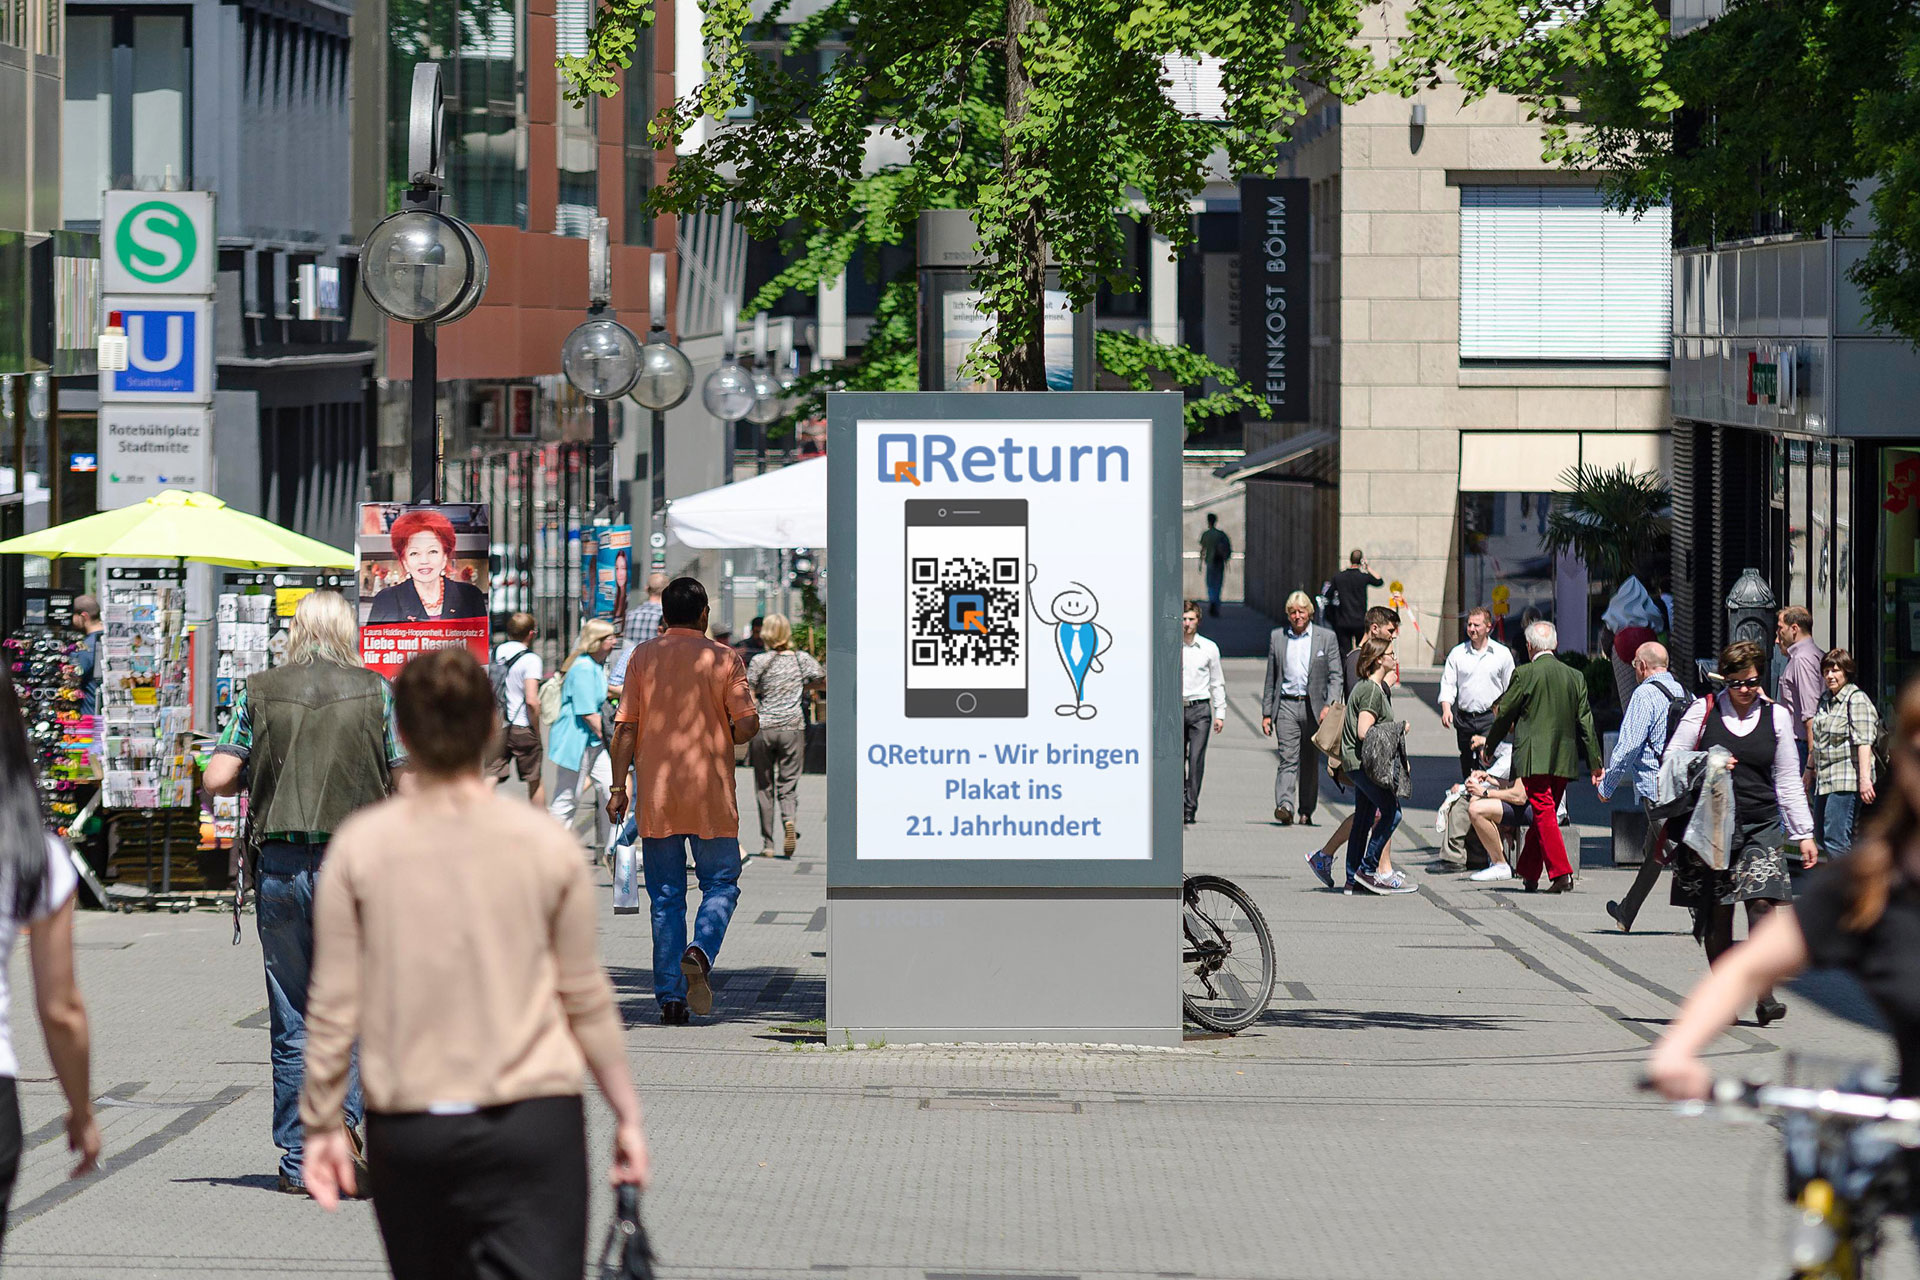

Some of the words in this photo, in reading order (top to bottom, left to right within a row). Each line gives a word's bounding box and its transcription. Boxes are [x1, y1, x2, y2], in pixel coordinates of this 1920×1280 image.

[129, 208, 182, 276] S
[1263, 196, 1287, 272] BÖHM
[128, 315, 183, 373] U
[1265, 284, 1287, 404] FEINKOST
[127, 376, 184, 388] Stadtbahn
[109, 424, 200, 438] Rotebühlplatz
[119, 441, 189, 454] Stadtmitte
[878, 433, 1129, 486] QReturn
[364, 628, 381, 636] Laura
[478, 629, 485, 637] 2
[364, 638, 395, 650] Liebe
[397, 638, 419, 650] und
[364, 651, 380, 664] für
[382, 650, 404, 664] alle
[868, 744, 971, 767] QReturn
[994, 743, 1039, 764] Wir
[1046, 743, 1139, 769] bringen
[945, 778, 1021, 799] Plakat
[1028, 779, 1062, 799] ins
[906, 815, 943, 836] 21.
[949, 815, 1101, 837] Jahrhundert
